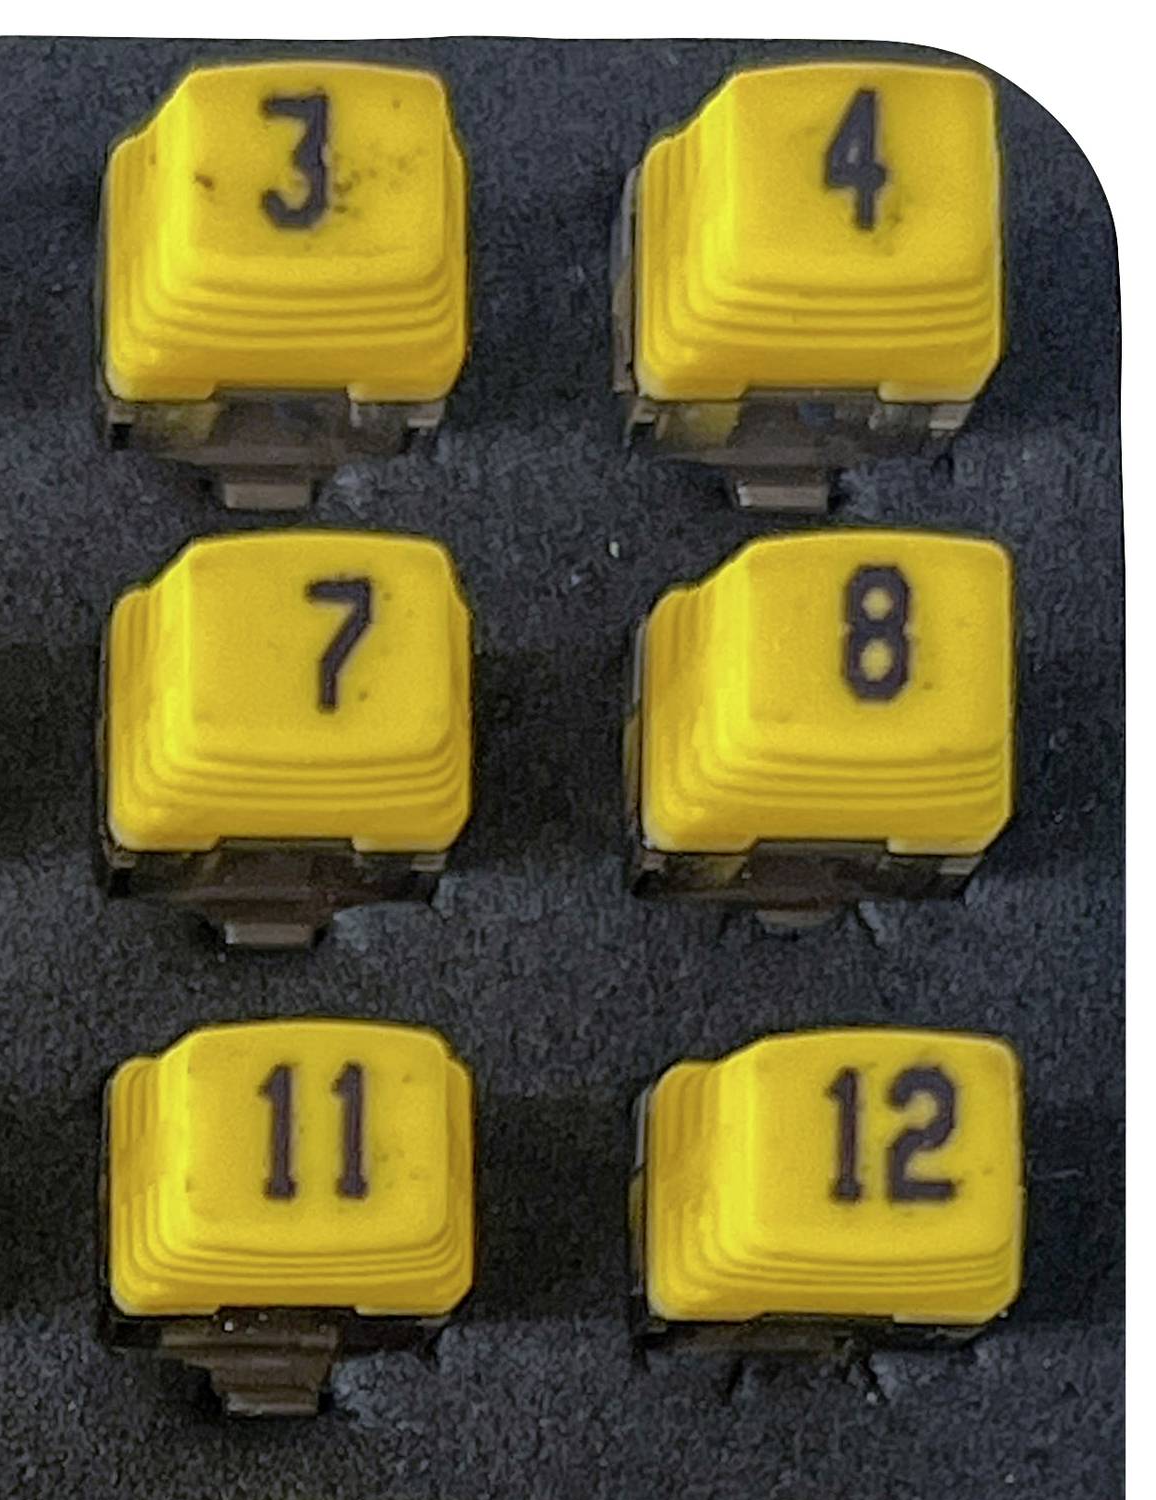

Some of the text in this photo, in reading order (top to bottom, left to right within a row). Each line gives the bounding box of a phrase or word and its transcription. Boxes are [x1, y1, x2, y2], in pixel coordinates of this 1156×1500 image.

[259, 86, 332, 232] 3
[822, 87, 892, 232] 4
[305, 574, 374, 714] 7
[840, 563, 914, 703] 8
[258, 1061, 369, 1202] 11
[825, 1062, 960, 1205] 12
